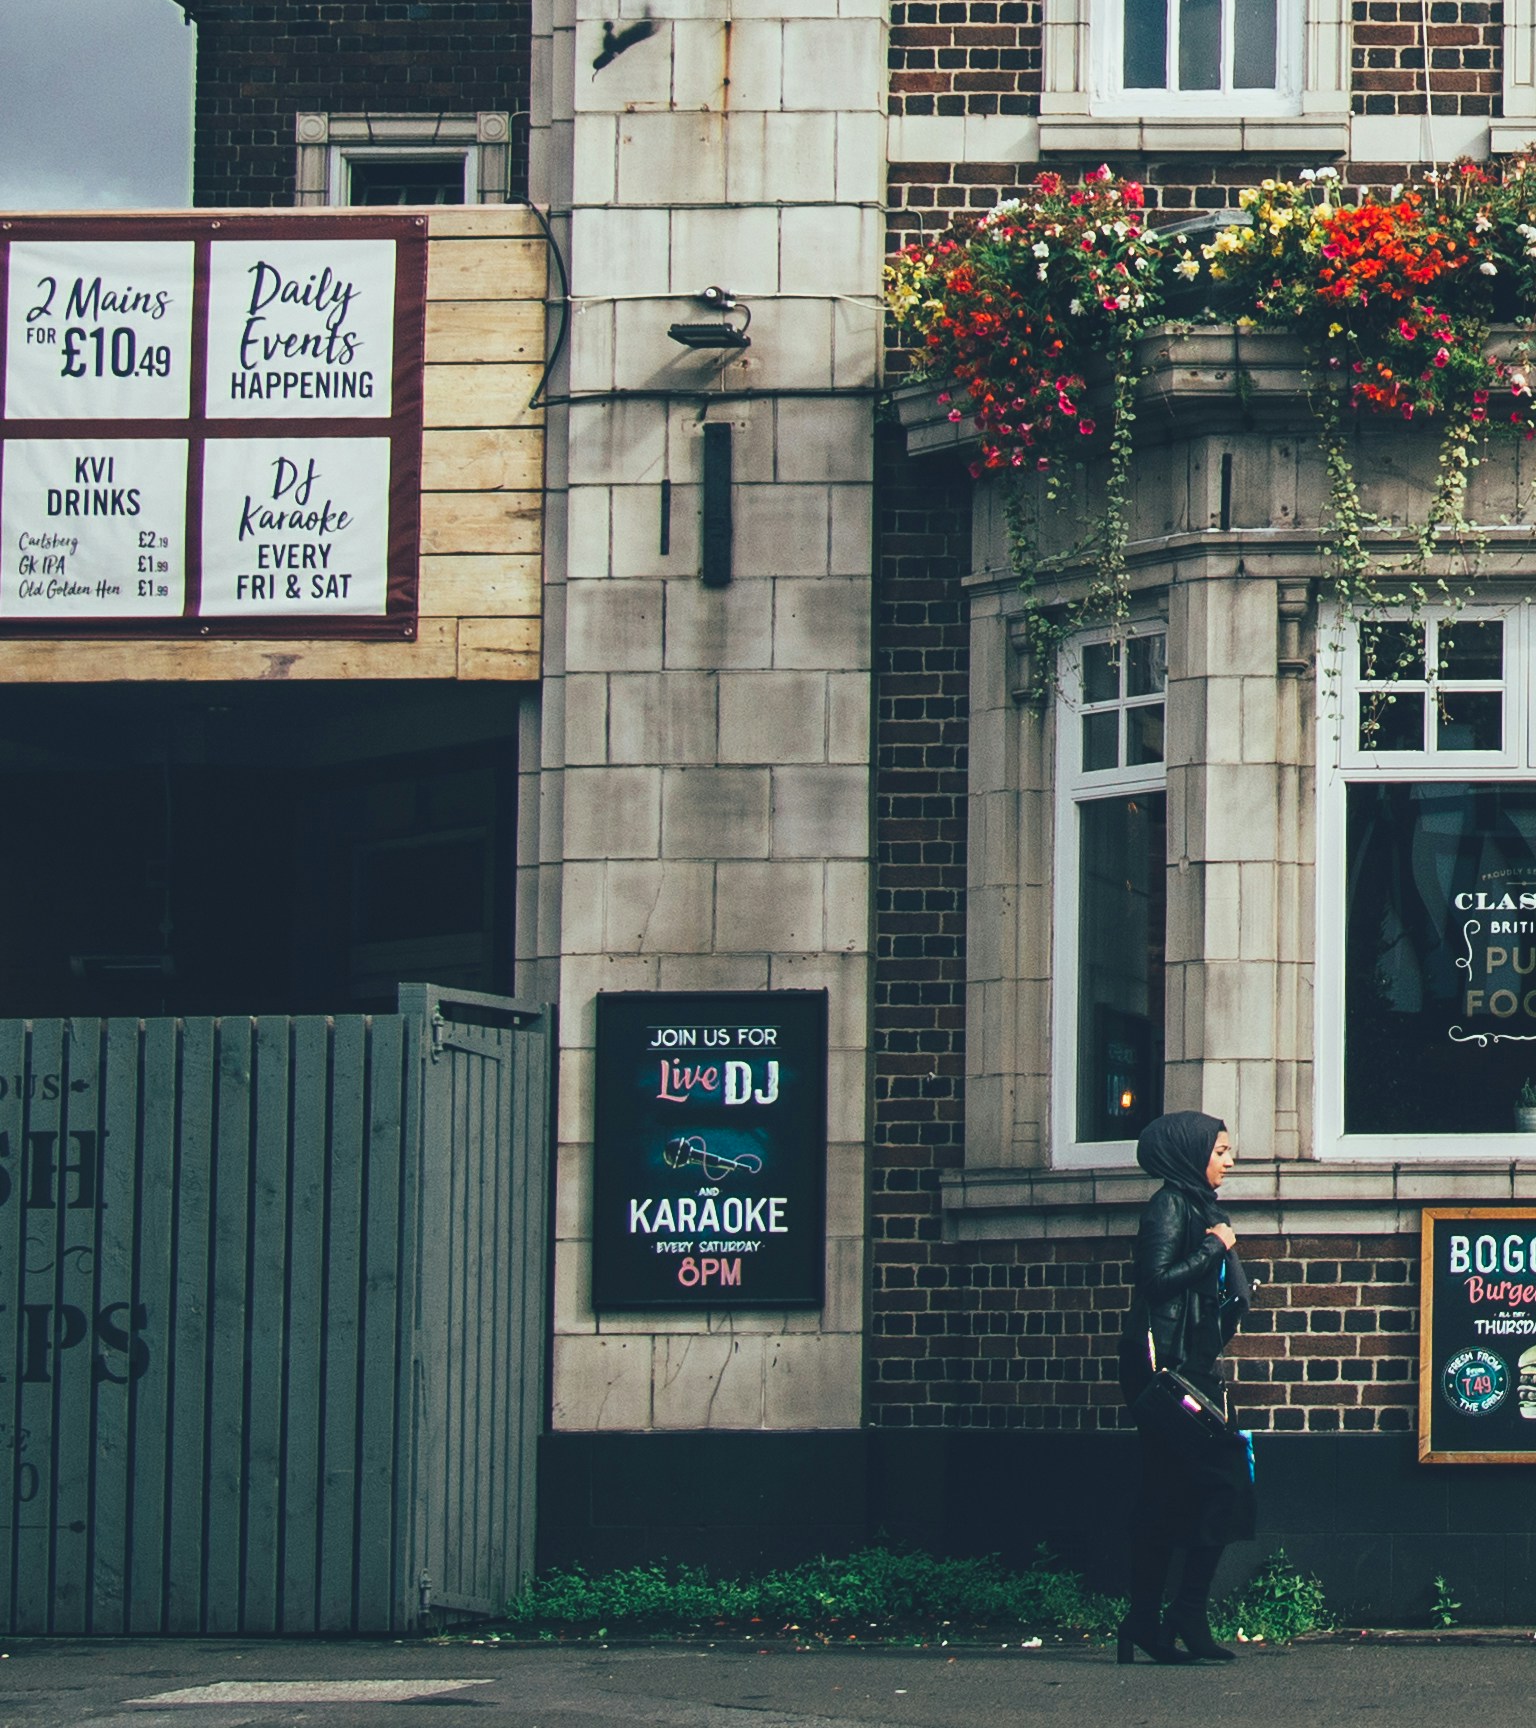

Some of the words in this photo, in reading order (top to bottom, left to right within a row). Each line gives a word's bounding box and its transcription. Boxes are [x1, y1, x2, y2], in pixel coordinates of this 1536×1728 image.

[26, 276, 57, 322] 2
[65, 276, 174, 322] Mains
[247, 261, 362, 331] Daily
[26, 328, 56, 344] FOR
[61, 326, 171, 378] £10.49
[240, 316, 364, 370] Events
[231, 371, 373, 399] HAPPENING
[75, 456, 114, 483] KVI
[271, 456, 322, 506] DJ
[47, 488, 141, 516] DRINKS
[239, 495, 354, 541] Karaoke
[18, 531, 79, 555] Carlsberg
[138, 531, 169, 548] £2.19
[258, 543, 332, 569] EVERY
[42, 555, 65, 575] IPA
[18, 579, 43, 598] Old
[46, 579, 91, 599] Golden
[95, 579, 120, 598] Hen
[236, 574, 274, 600] FRI
[285, 574, 301, 599] &
[310, 574, 352, 599] SAT
[650, 1028, 697, 1046] JOIN
[703, 1028, 731, 1046] US
[737, 1028, 777, 1046] FOR
[656, 1058, 719, 1103] Live
[724, 1060, 779, 1105] DJ
[698, 1187, 719, 1197] AND
[629, 1197, 789, 1234] KARAOKE
[656, 1241, 694, 1254] EVERY
[699, 1240, 762, 1253] SATURDAY
[677, 1256, 742, 1287] 8PM
[1447, 1350, 1474, 1375] FRESH
[1476, 1350, 1502, 1372] FROM
[1461, 1375, 1492, 1397] 7.49
[1458, 1395, 1479, 1413] THE
[1481, 1388, 1505, 1411] GRILL
